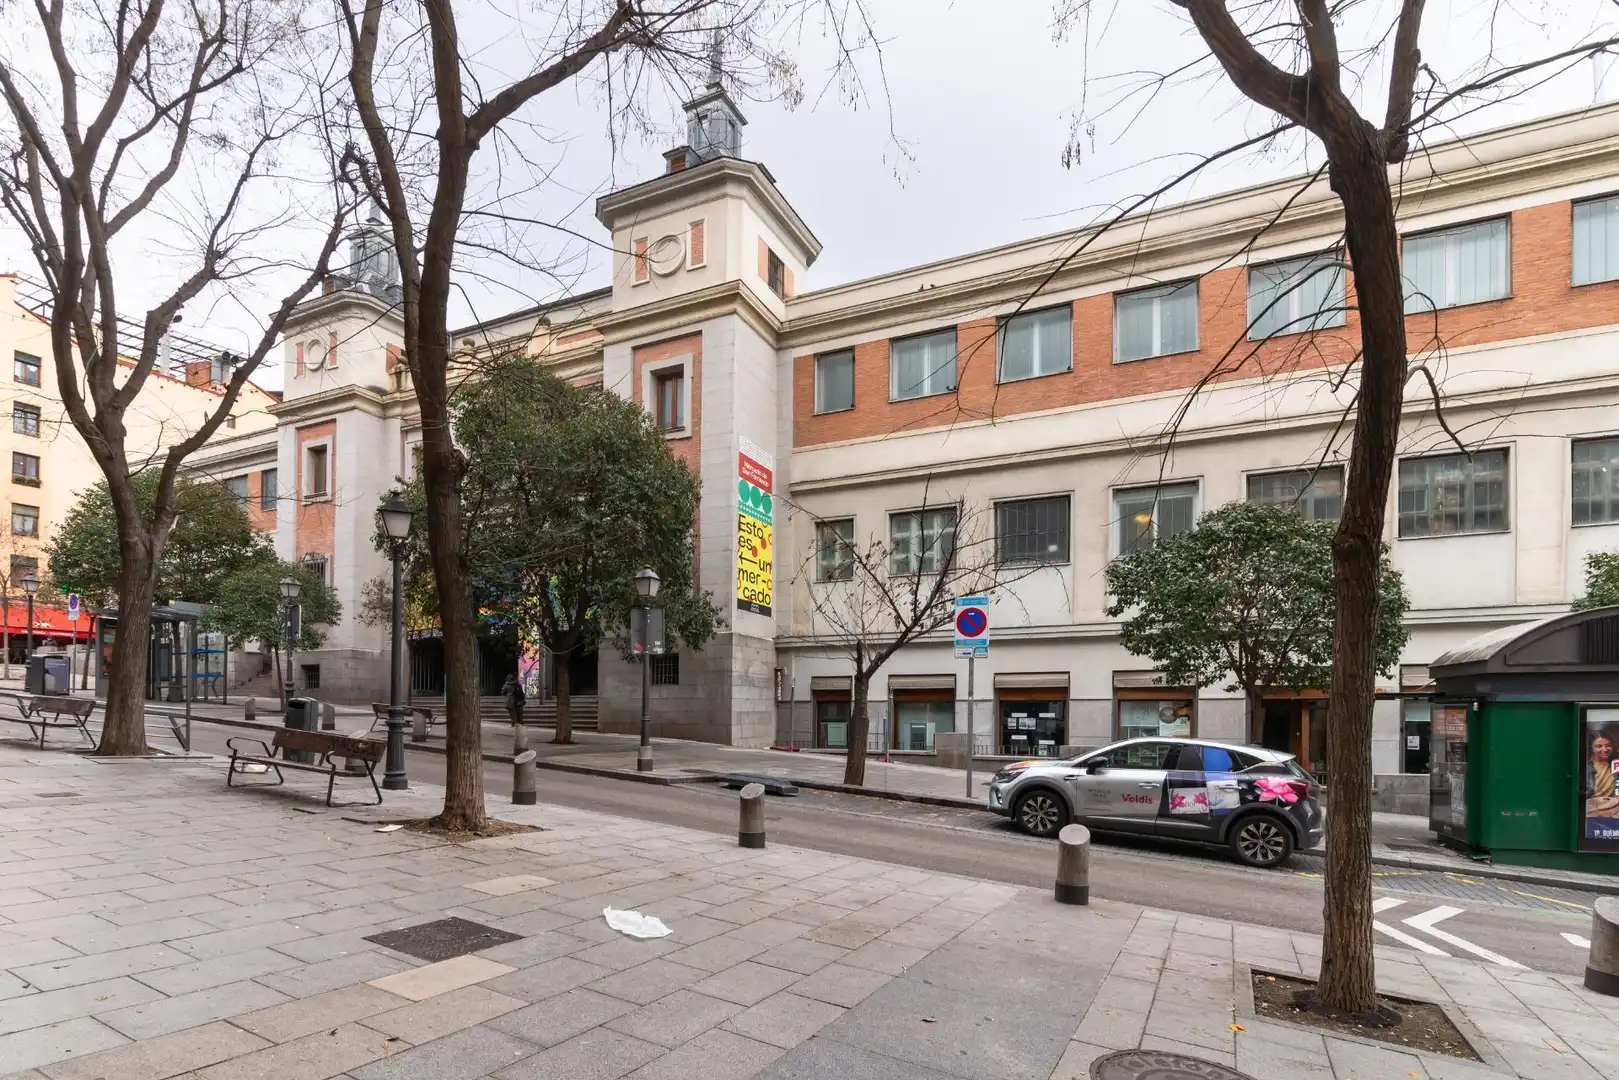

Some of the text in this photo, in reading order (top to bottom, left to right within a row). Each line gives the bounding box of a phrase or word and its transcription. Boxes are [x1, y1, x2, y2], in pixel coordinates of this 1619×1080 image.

[743, 460, 762, 477] Mercado
[738, 514, 764, 540] Esto
[738, 535, 753, 551] es
[758, 558, 772, 574] un
[738, 567, 767, 585] mer-
[742, 586, 771, 606] cado
[1121, 793, 1153, 804] Voldis
